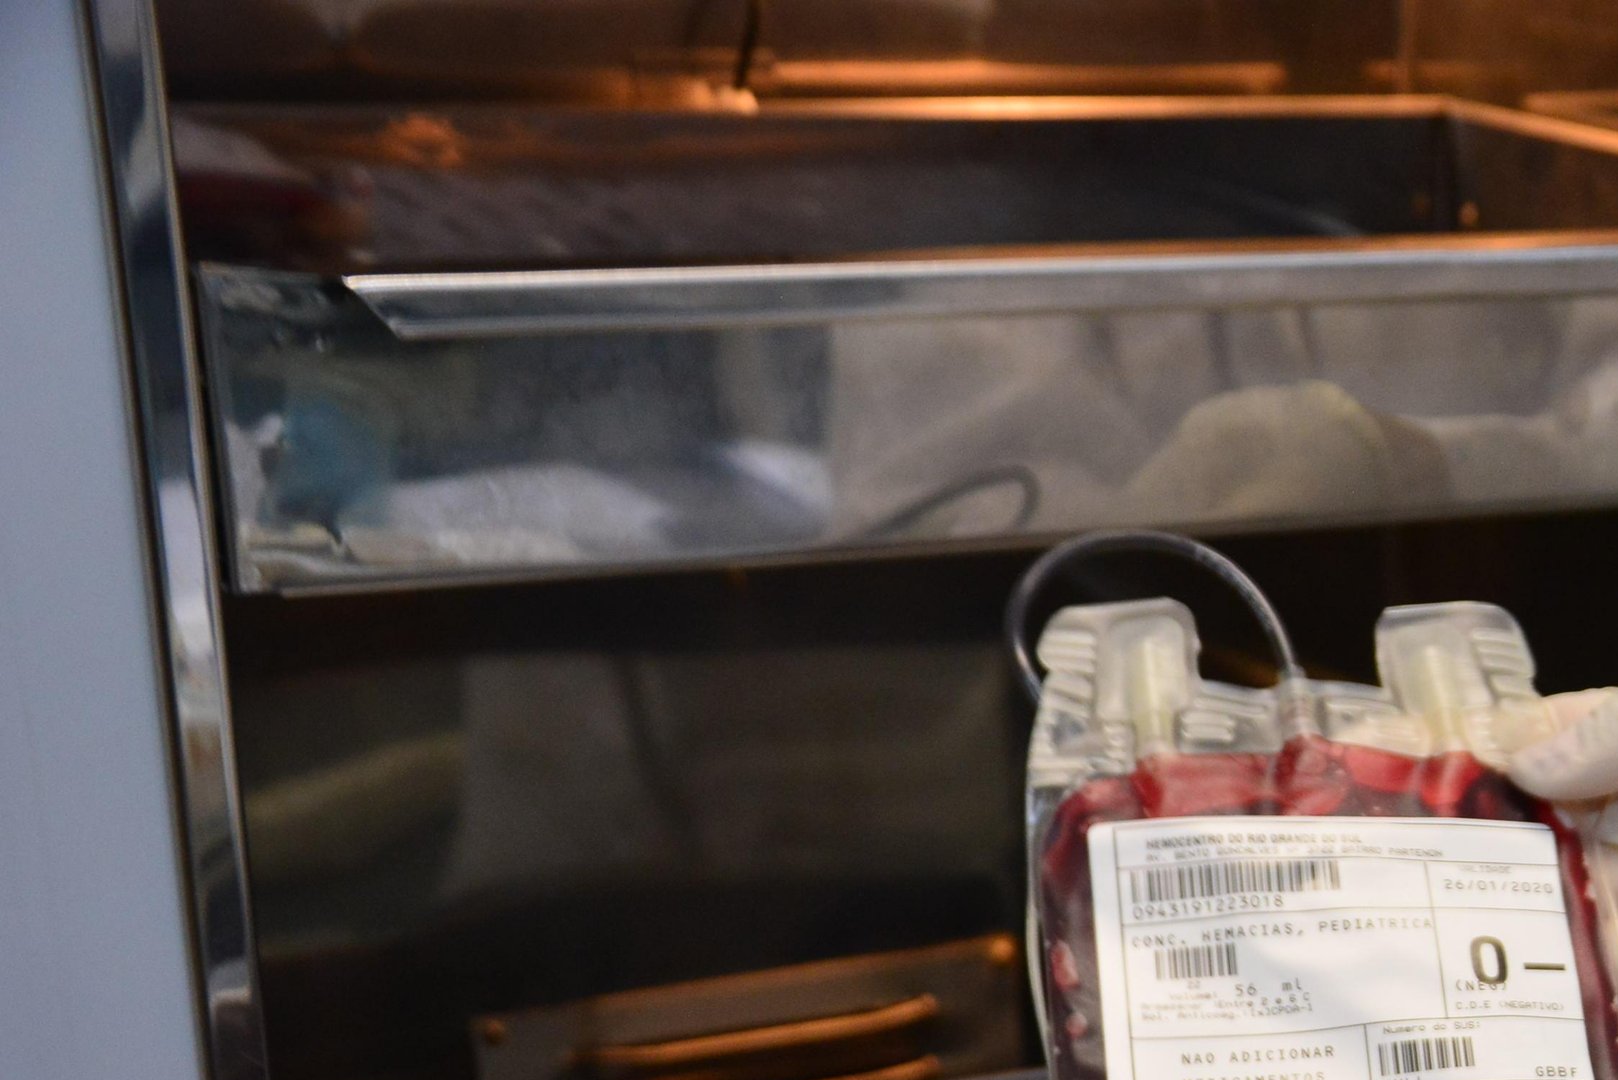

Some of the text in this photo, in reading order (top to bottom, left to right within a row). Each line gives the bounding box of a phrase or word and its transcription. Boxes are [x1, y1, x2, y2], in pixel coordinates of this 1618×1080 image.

[1443, 878, 1553, 894] 26/01/2020
[1132, 931, 1188, 949] CONC.
[1319, 917, 1433, 933] PEDIATRICA
[1234, 982, 1257, 997] 56
[1282, 977, 1302, 992] ml
[1181, 1044, 1335, 1066] NAO ADICIONAR
[1535, 1066, 1578, 1078] GBBF
